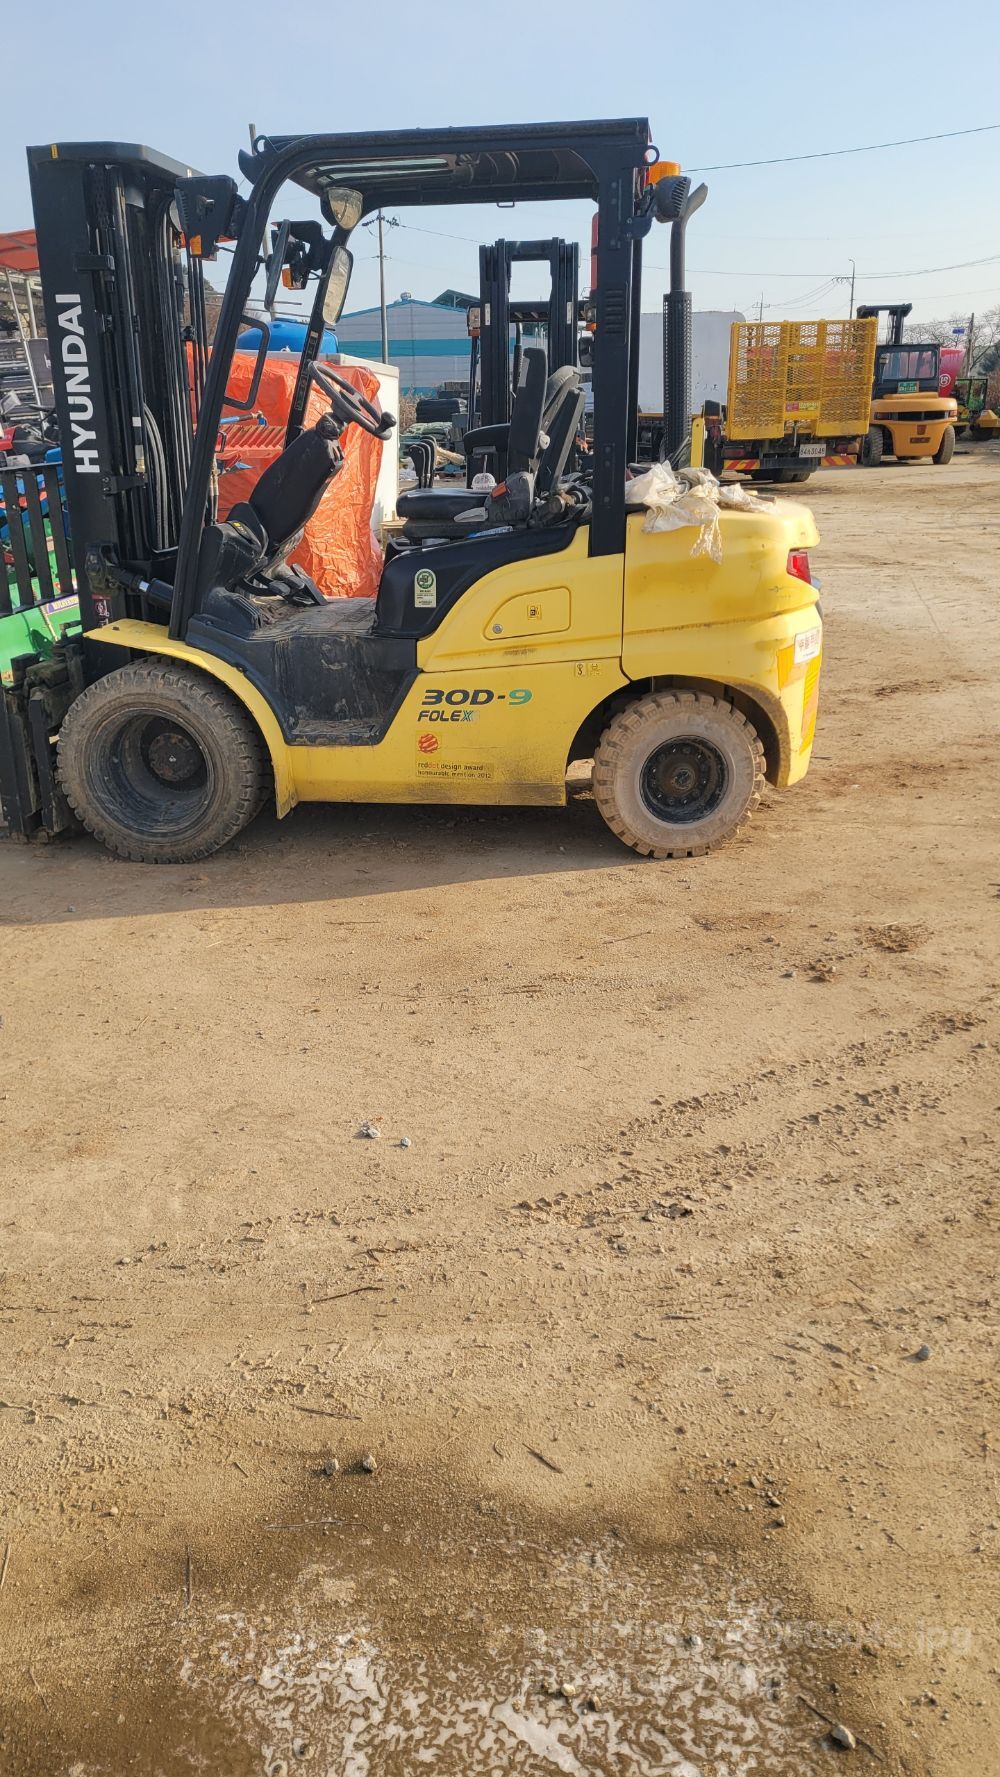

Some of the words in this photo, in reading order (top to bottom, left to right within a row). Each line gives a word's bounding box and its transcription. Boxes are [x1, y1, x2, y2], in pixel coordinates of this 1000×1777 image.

[55, 293, 101, 473] HYUNDAI
[421, 689, 533, 706] 30D-9
[417, 709, 475, 722] FOLEX
[440, 763, 462, 772] design
